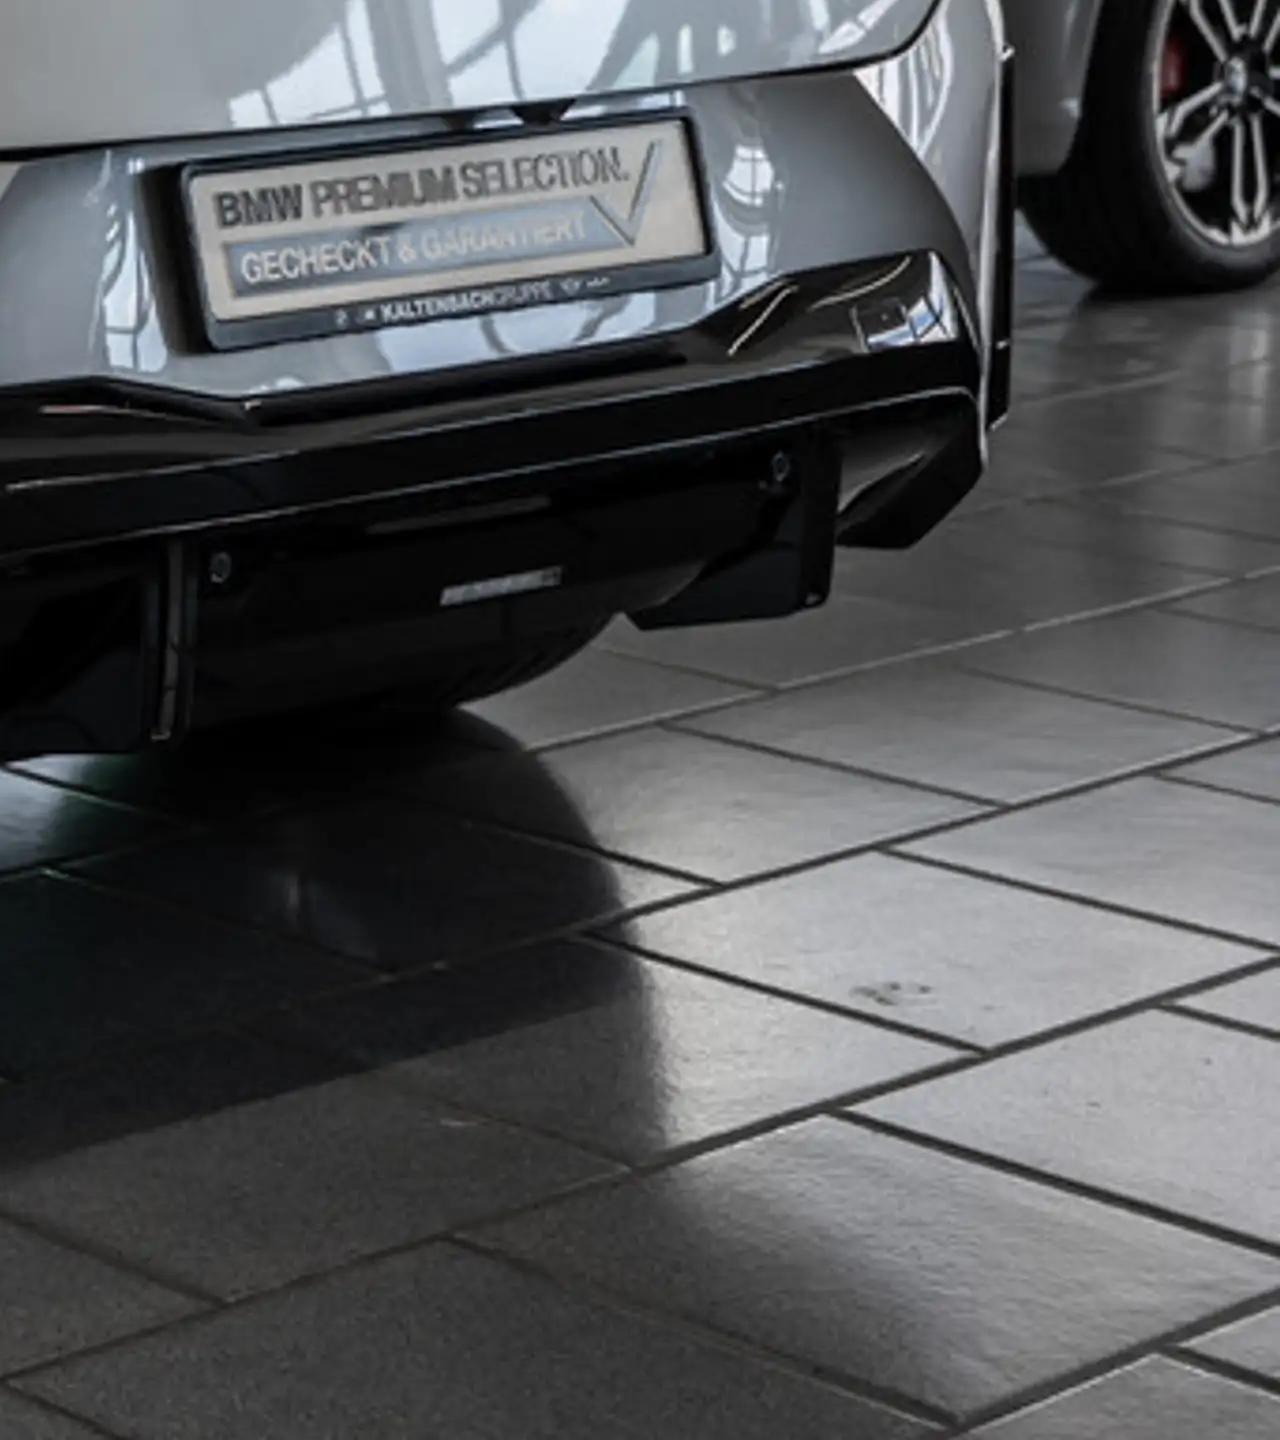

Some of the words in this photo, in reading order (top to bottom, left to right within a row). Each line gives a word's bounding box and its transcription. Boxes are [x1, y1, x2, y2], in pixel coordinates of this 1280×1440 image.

[213, 183, 303, 229] BMW
[308, 166, 459, 219] PREMIUM
[240, 235, 391, 285] GECHECKT
[397, 232, 418, 265] &
[420, 210, 588, 261] GARANTIERT
